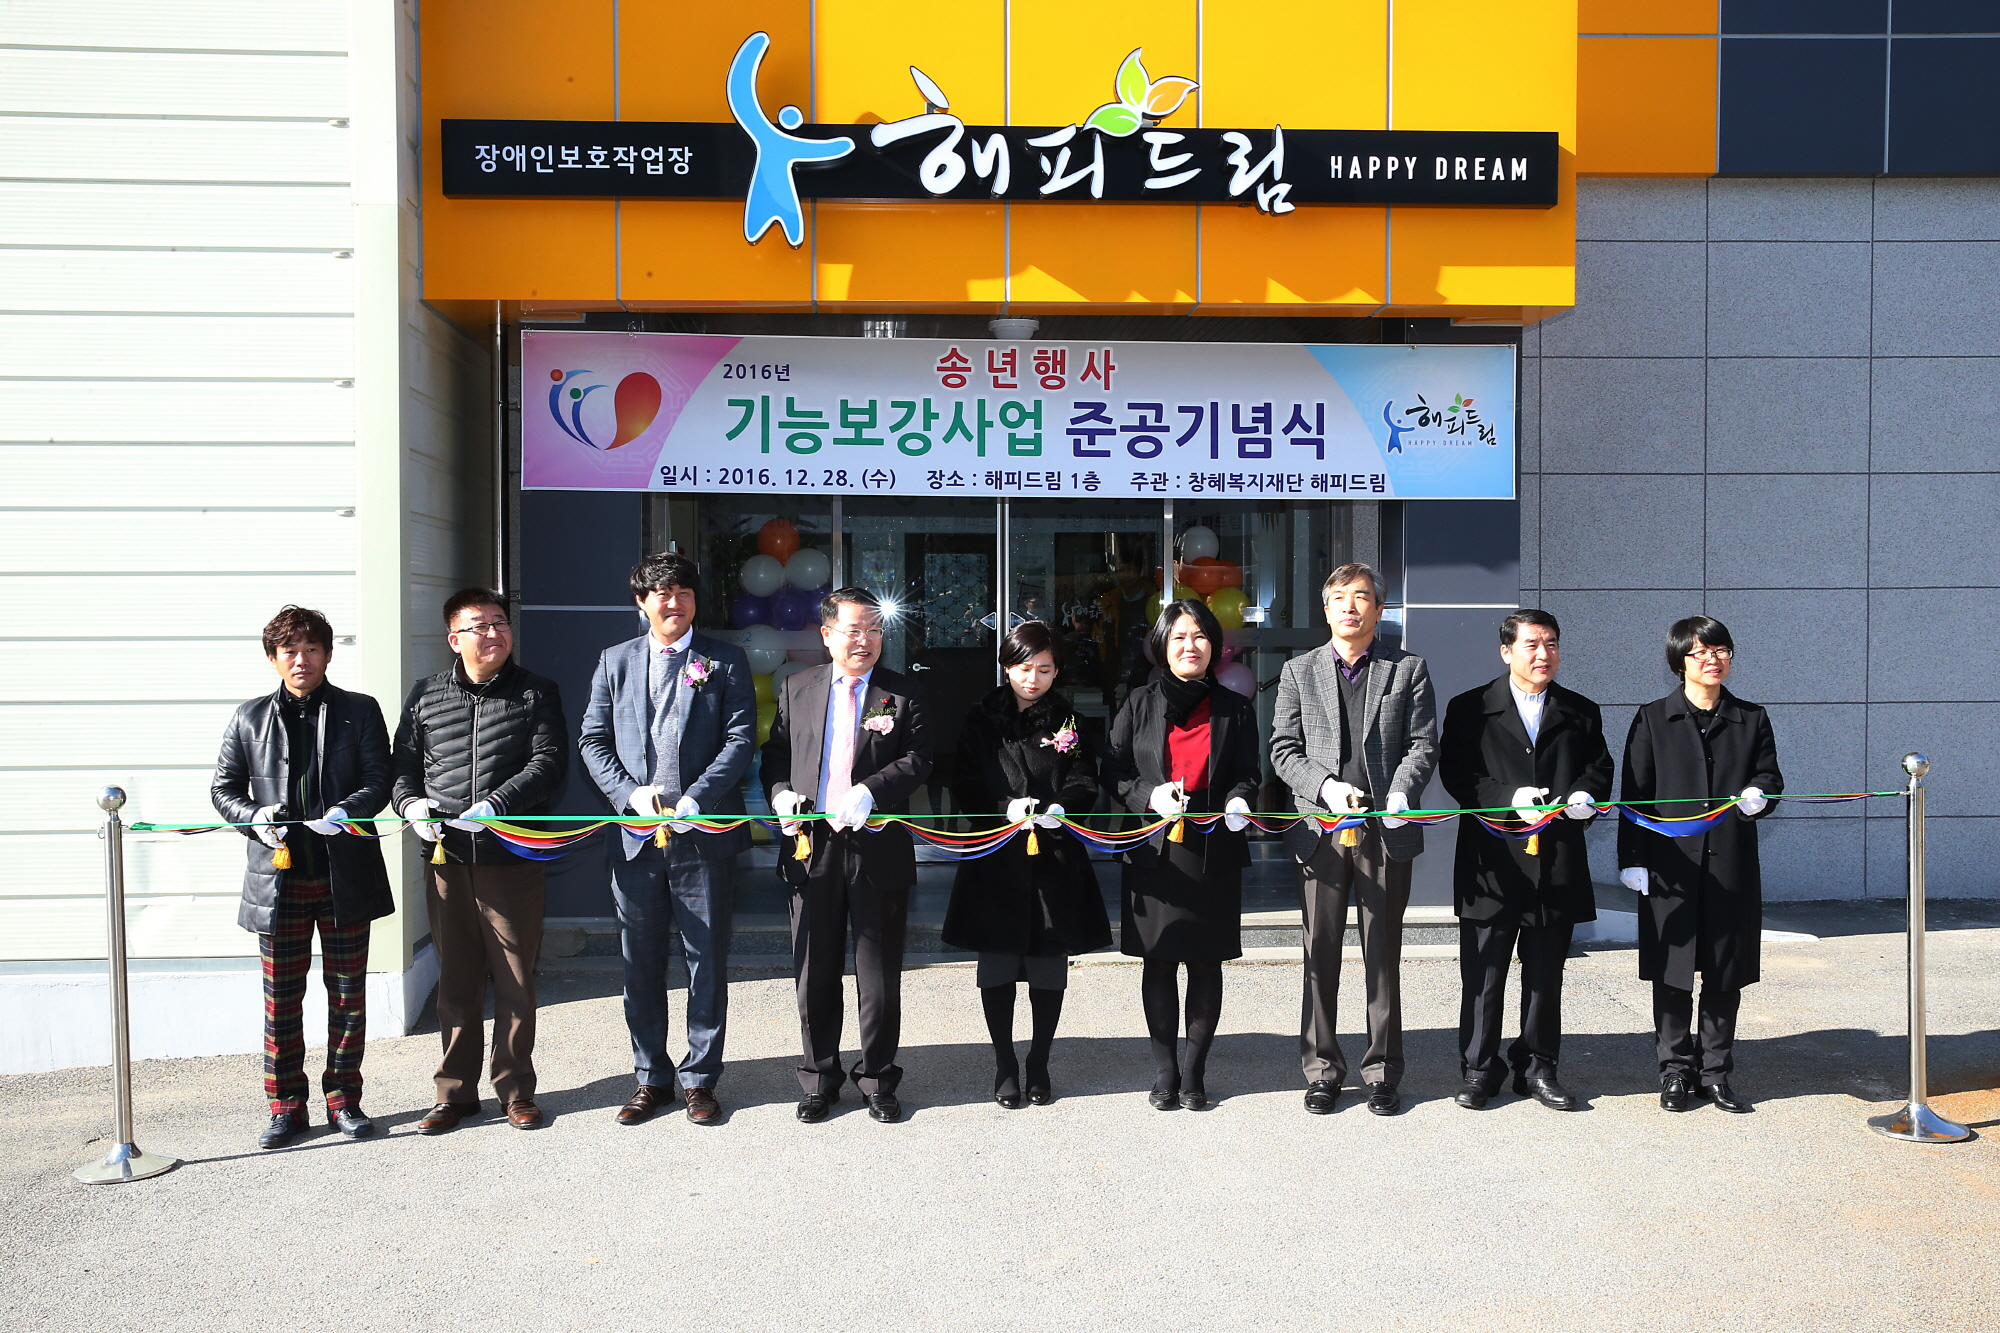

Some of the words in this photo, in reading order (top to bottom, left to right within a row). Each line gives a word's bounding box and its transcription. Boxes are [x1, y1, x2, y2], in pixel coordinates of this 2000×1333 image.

[871, 65, 1296, 215] 해피드림
[474, 144, 693, 175] 장애인보호작업장
[1330, 155, 1417, 180] HAPPY
[1435, 156, 1528, 181] DREAM
[722, 363, 792, 382] 2016년
[937, 346, 1116, 391] 송년행사
[725, 394, 1043, 458] 기능보강사업
[1065, 400, 1327, 460] 준공기념식
[1405, 393, 1497, 446] 해피드림
[659, 465, 698, 486] 일시
[718, 467, 777, 487] 2016.
[785, 468, 816, 487] 12.
[823, 469, 855, 488] 28.
[861, 468, 897, 490] (수)
[926, 470, 966, 489] 장소
[985, 470, 1062, 491] 해피드림
[1071, 471, 1101, 490] 1층
[1130, 472, 1169, 492] 주관
[1188, 472, 1305, 493] 창혜복지재단
[1310, 473, 1386, 493] 해피드림
